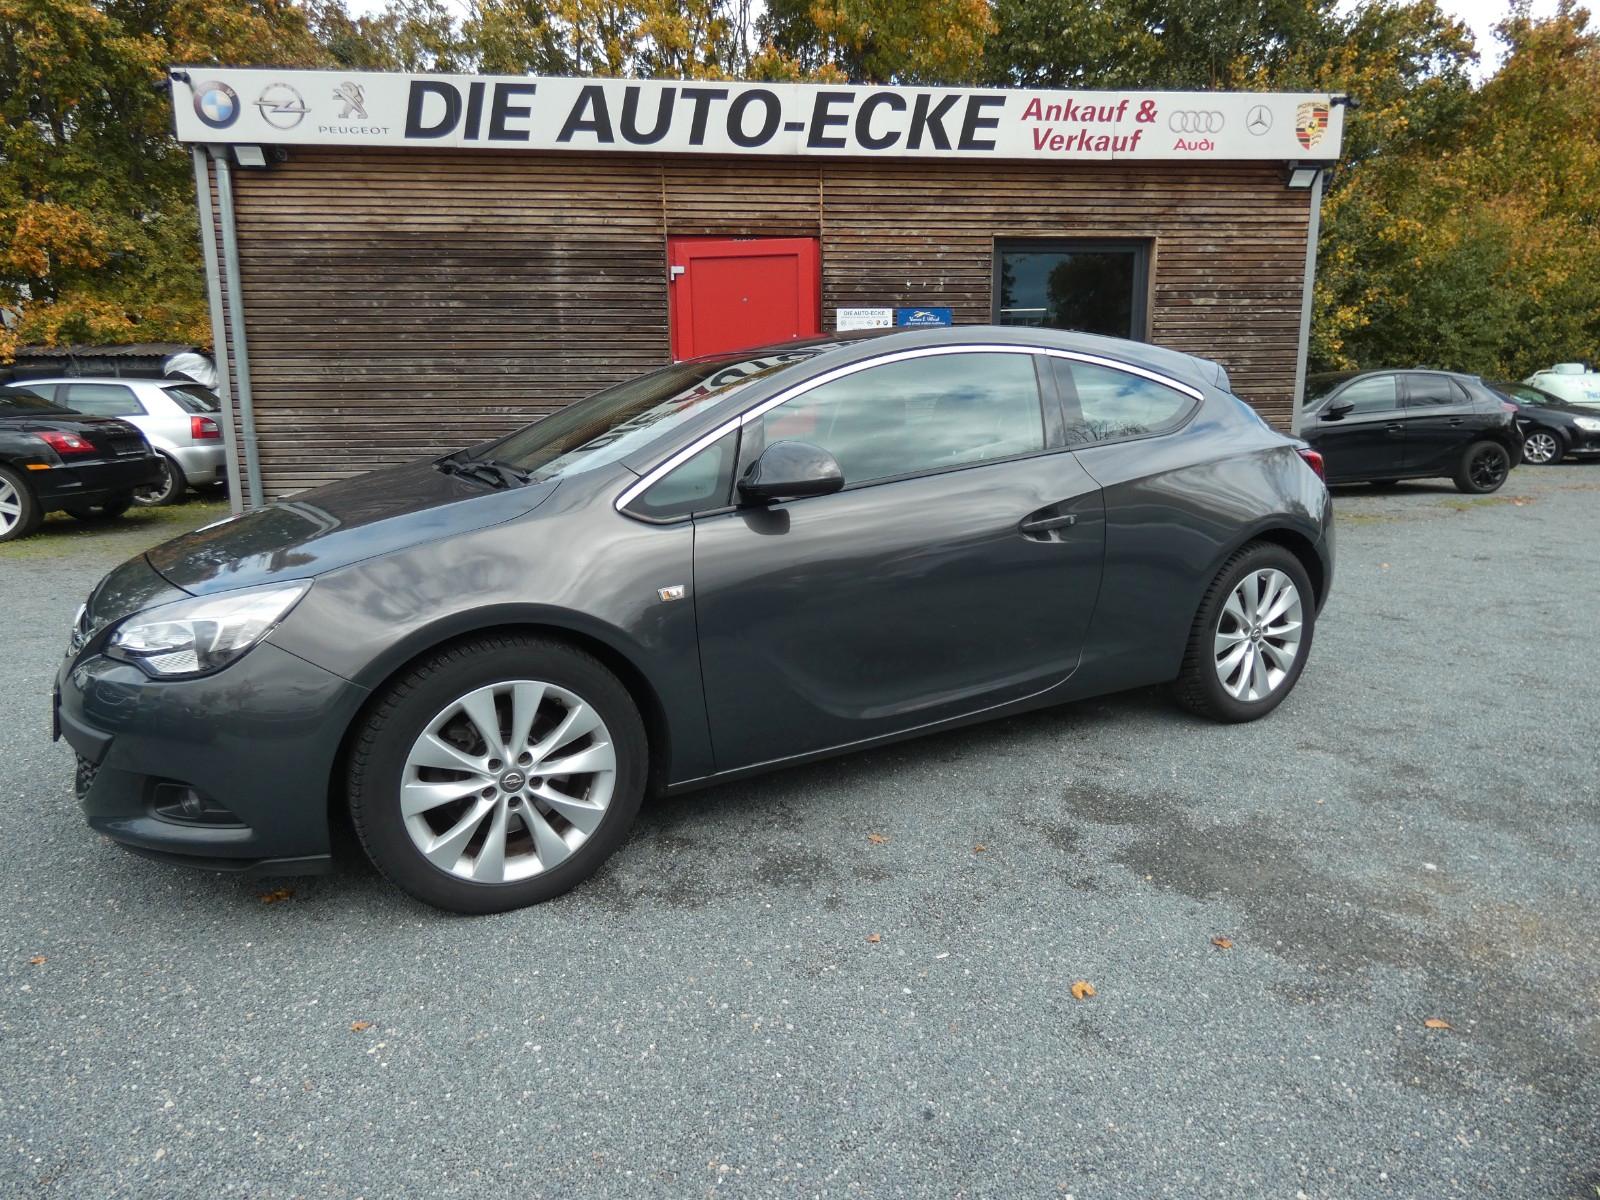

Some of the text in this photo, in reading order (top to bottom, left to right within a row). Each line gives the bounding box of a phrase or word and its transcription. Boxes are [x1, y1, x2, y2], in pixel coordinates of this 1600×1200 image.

[404, 80, 1007, 152] DIE AUTO-ECKE
[1021, 97, 1158, 124] Ankauf &
[318, 126, 391, 135] PEUGEOT
[1032, 127, 1143, 152] Verkauf
[1173, 138, 1215, 151] Audi
